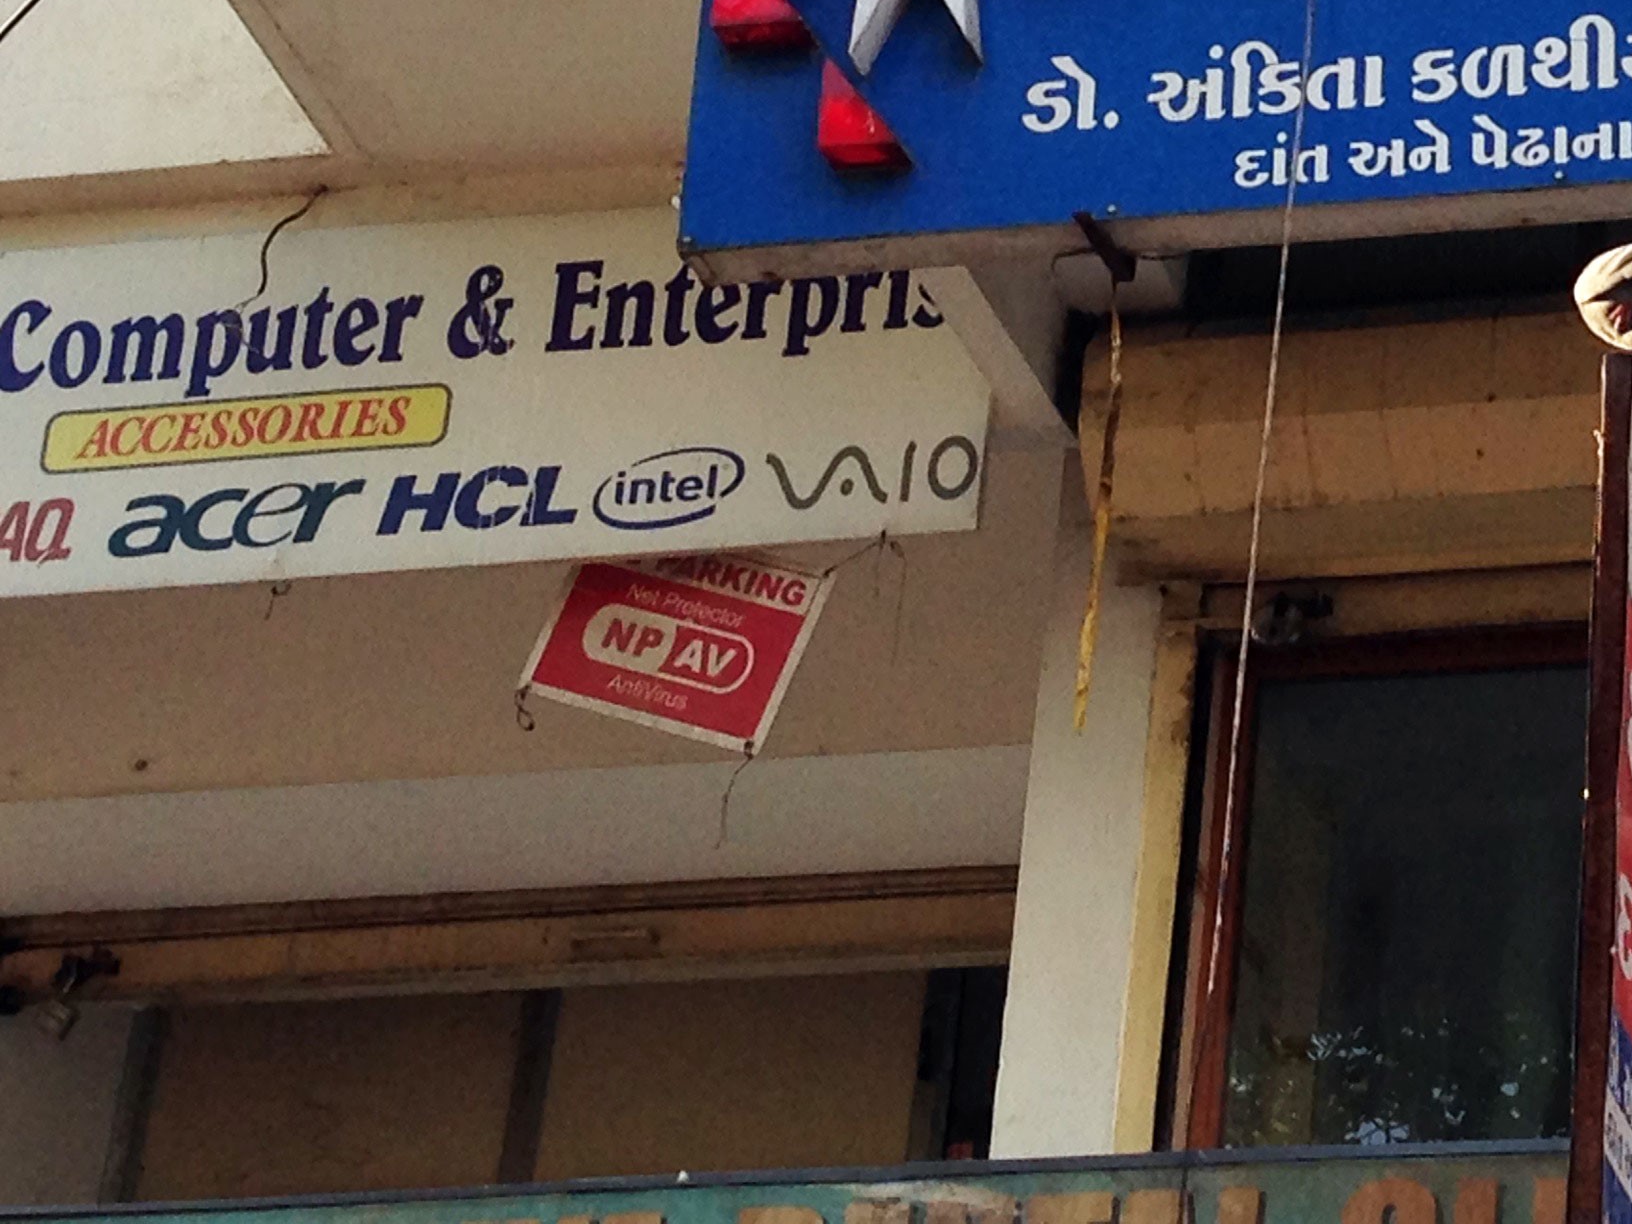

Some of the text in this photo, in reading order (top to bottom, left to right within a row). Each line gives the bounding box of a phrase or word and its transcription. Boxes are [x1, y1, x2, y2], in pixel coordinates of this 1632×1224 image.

[1146, 40, 1386, 123] અંકિતા
[1233, 131, 1330, 188] દાંત
[1347, 118, 1452, 177] અને
[0, 287, 424, 398] Computer
[447, 264, 515, 359] &
[75, 395, 413, 461] ACCESSORIES
[107, 478, 367, 558] acer
[375, 465, 578, 536] HCL
[614, 464, 718, 506] intel
[764, 435, 979, 510] VAIO
